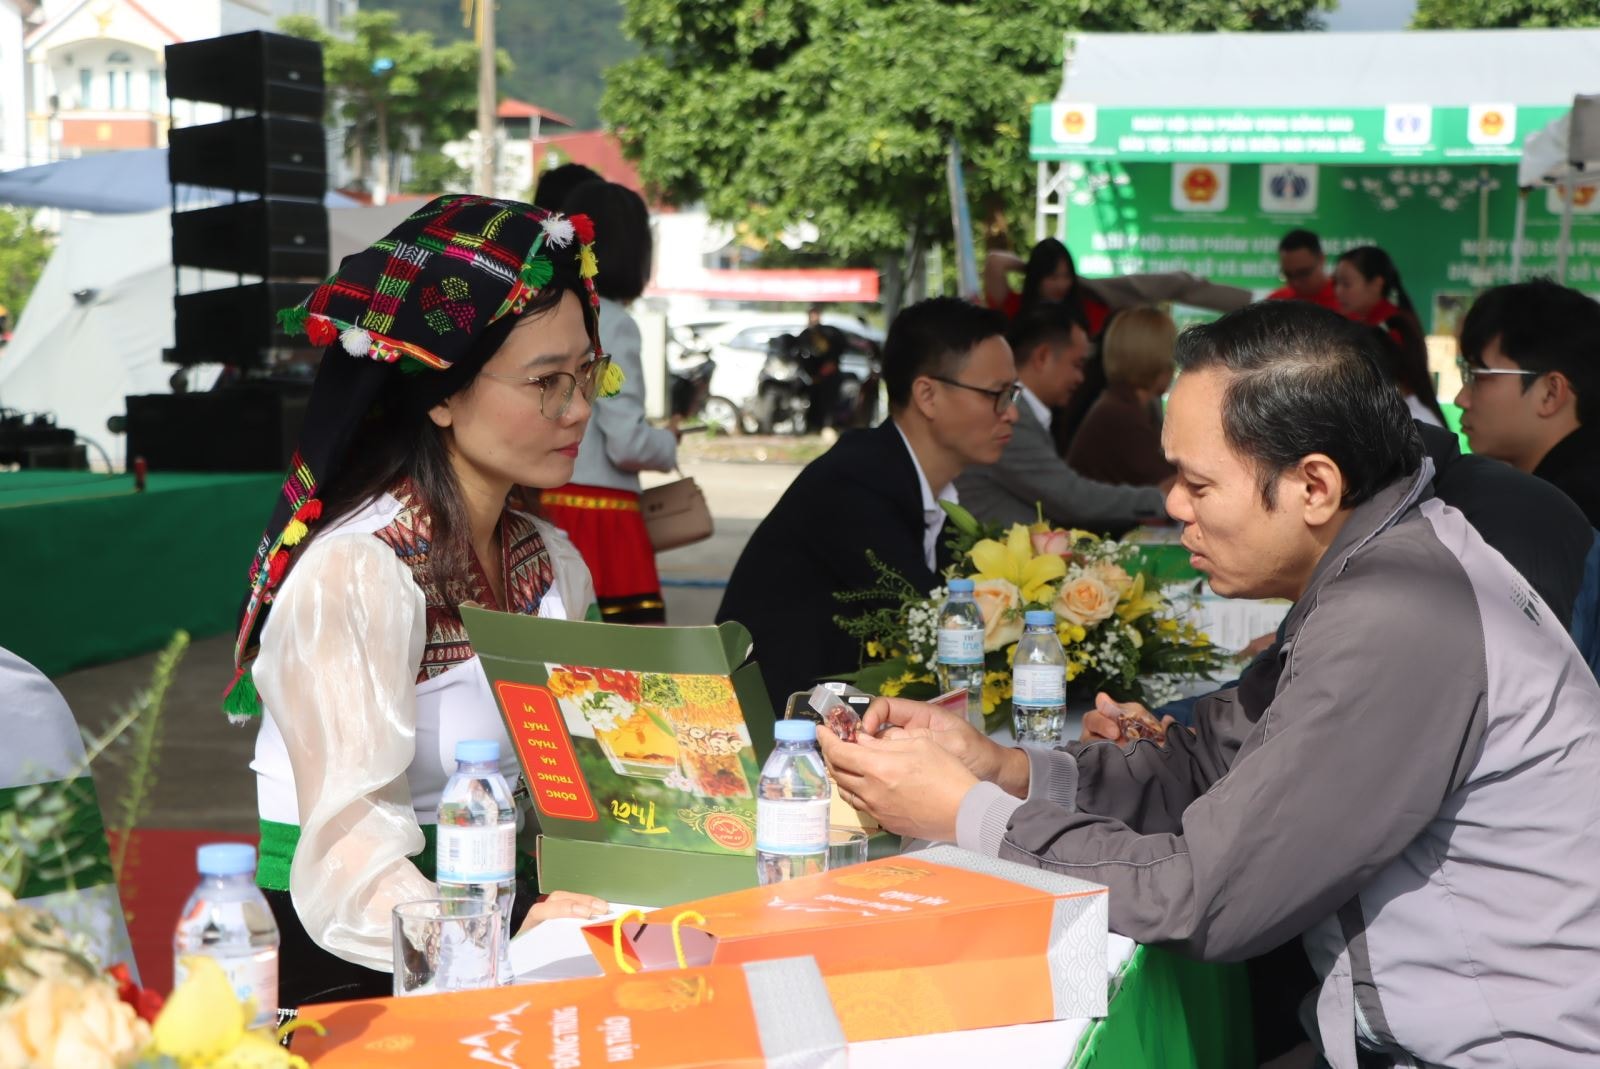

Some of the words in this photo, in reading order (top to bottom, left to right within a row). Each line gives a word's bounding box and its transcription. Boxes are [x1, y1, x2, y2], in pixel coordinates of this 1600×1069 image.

[962, 641, 980, 651] true
[523, 702, 537, 714] VỊ
[523, 720, 551, 732] THẤT
[528, 738, 558, 750] THẢO
[541, 755, 558, 766] HẠ
[537, 772, 574, 784] TRÙNG
[546, 789, 578, 801] ĐÔNG
[547, 1005, 579, 1035] TRÙNG
[596, 1015, 632, 1046] THẢO
[548, 1034, 581, 1069] ĐÔNG
[607, 1044, 640, 1063] HẠ
